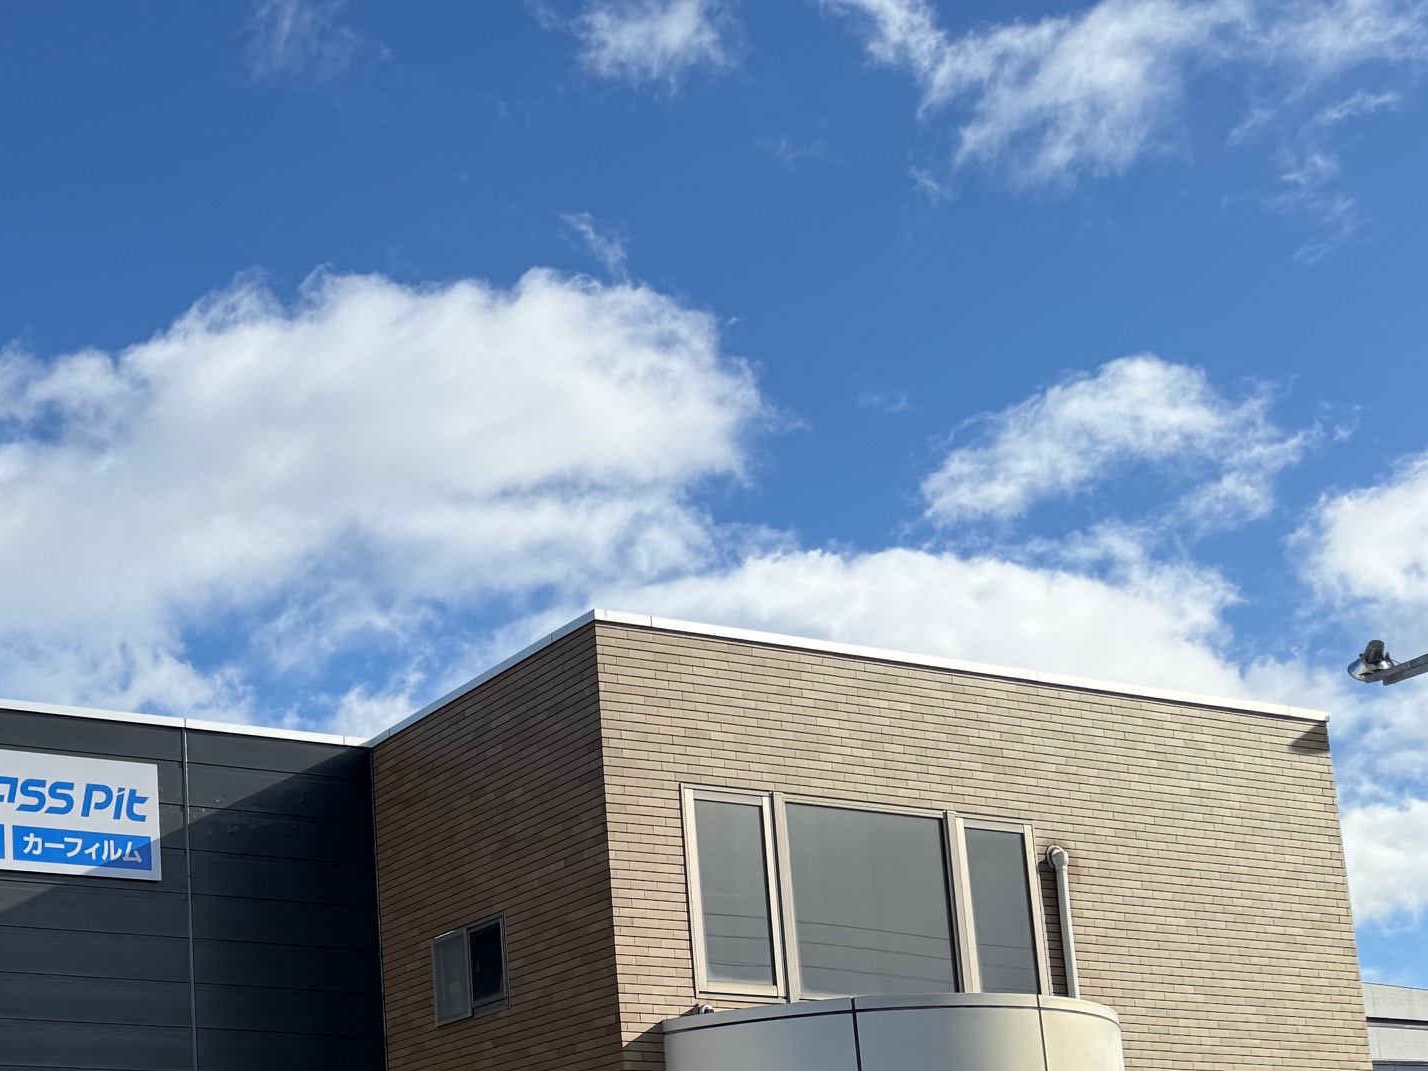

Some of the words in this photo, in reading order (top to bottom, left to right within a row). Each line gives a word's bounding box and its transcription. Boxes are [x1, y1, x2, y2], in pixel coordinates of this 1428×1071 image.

[22, 832, 144, 864] カーフィルム
